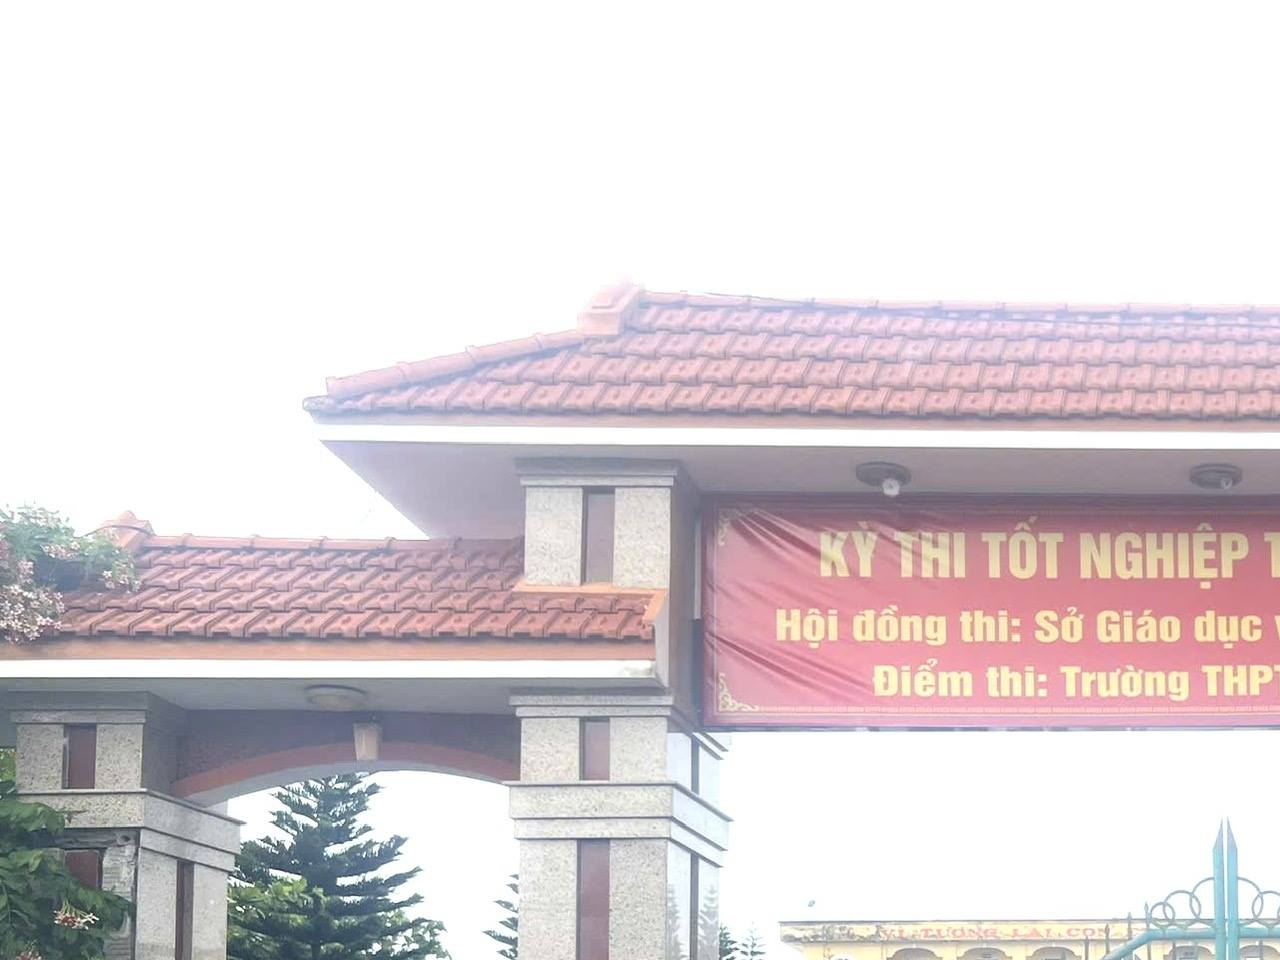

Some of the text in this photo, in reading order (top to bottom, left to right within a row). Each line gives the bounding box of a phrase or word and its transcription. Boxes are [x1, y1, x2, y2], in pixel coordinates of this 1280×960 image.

[820, 521, 878, 578] KỲ
[893, 531, 967, 579] THI
[982, 515, 1064, 580] TỐT
[1080, 522, 1249, 590] NGHIỆP
[776, 608, 839, 649] Hội
[852, 605, 949, 646] đồng
[959, 609, 1022, 643] thi:
[1034, 606, 1085, 644] Sở
[1096, 609, 1182, 644] Giáo
[1193, 609, 1264, 650] dục
[873, 658, 974, 698] Điểm
[986, 665, 1048, 698] thi:
[1060, 665, 1191, 701] Trường
